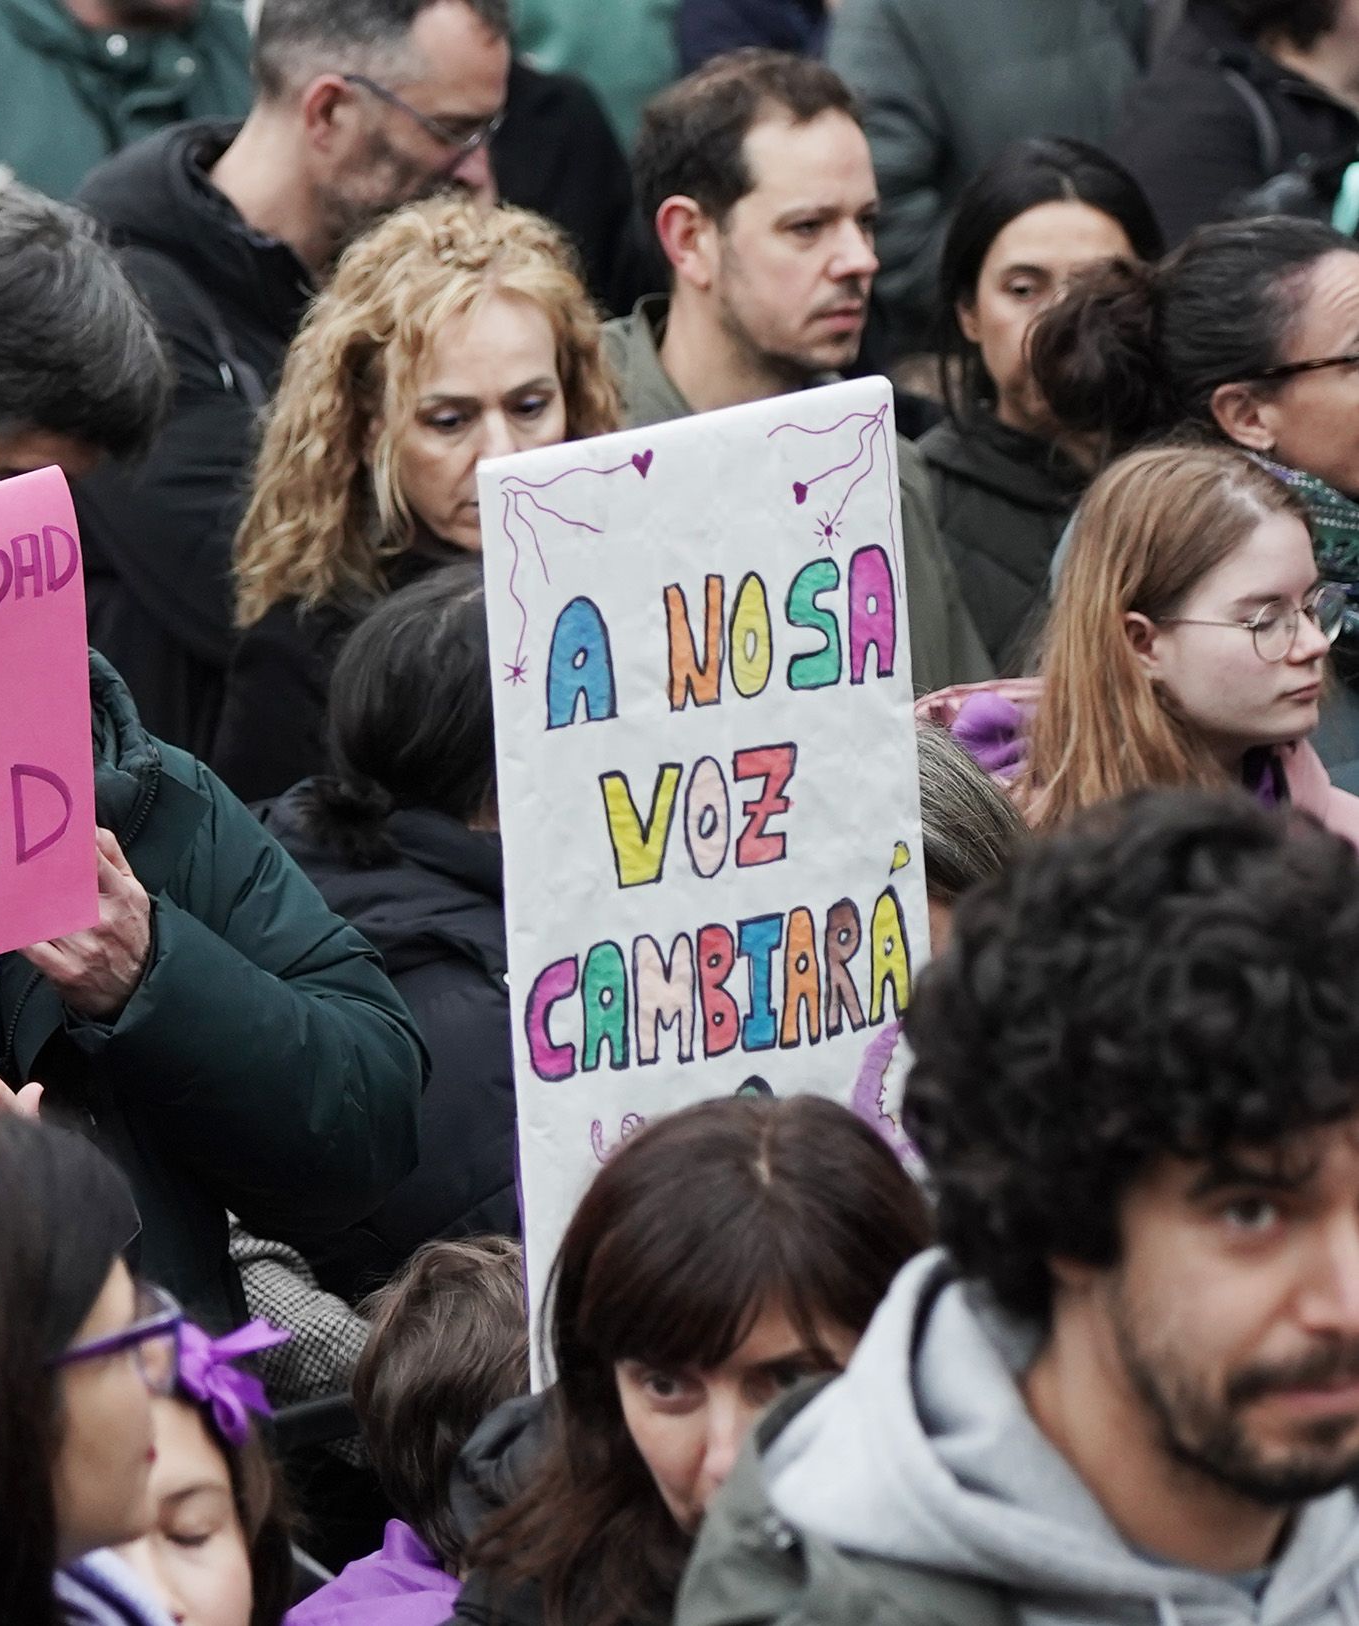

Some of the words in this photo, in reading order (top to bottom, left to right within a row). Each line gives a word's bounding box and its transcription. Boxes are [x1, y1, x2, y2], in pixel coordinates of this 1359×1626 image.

[545, 595, 618, 731] A
[664, 544, 896, 712] NOSA
[598, 741, 797, 888] VOZ
[525, 840, 912, 1081] CAMBIARÁ
